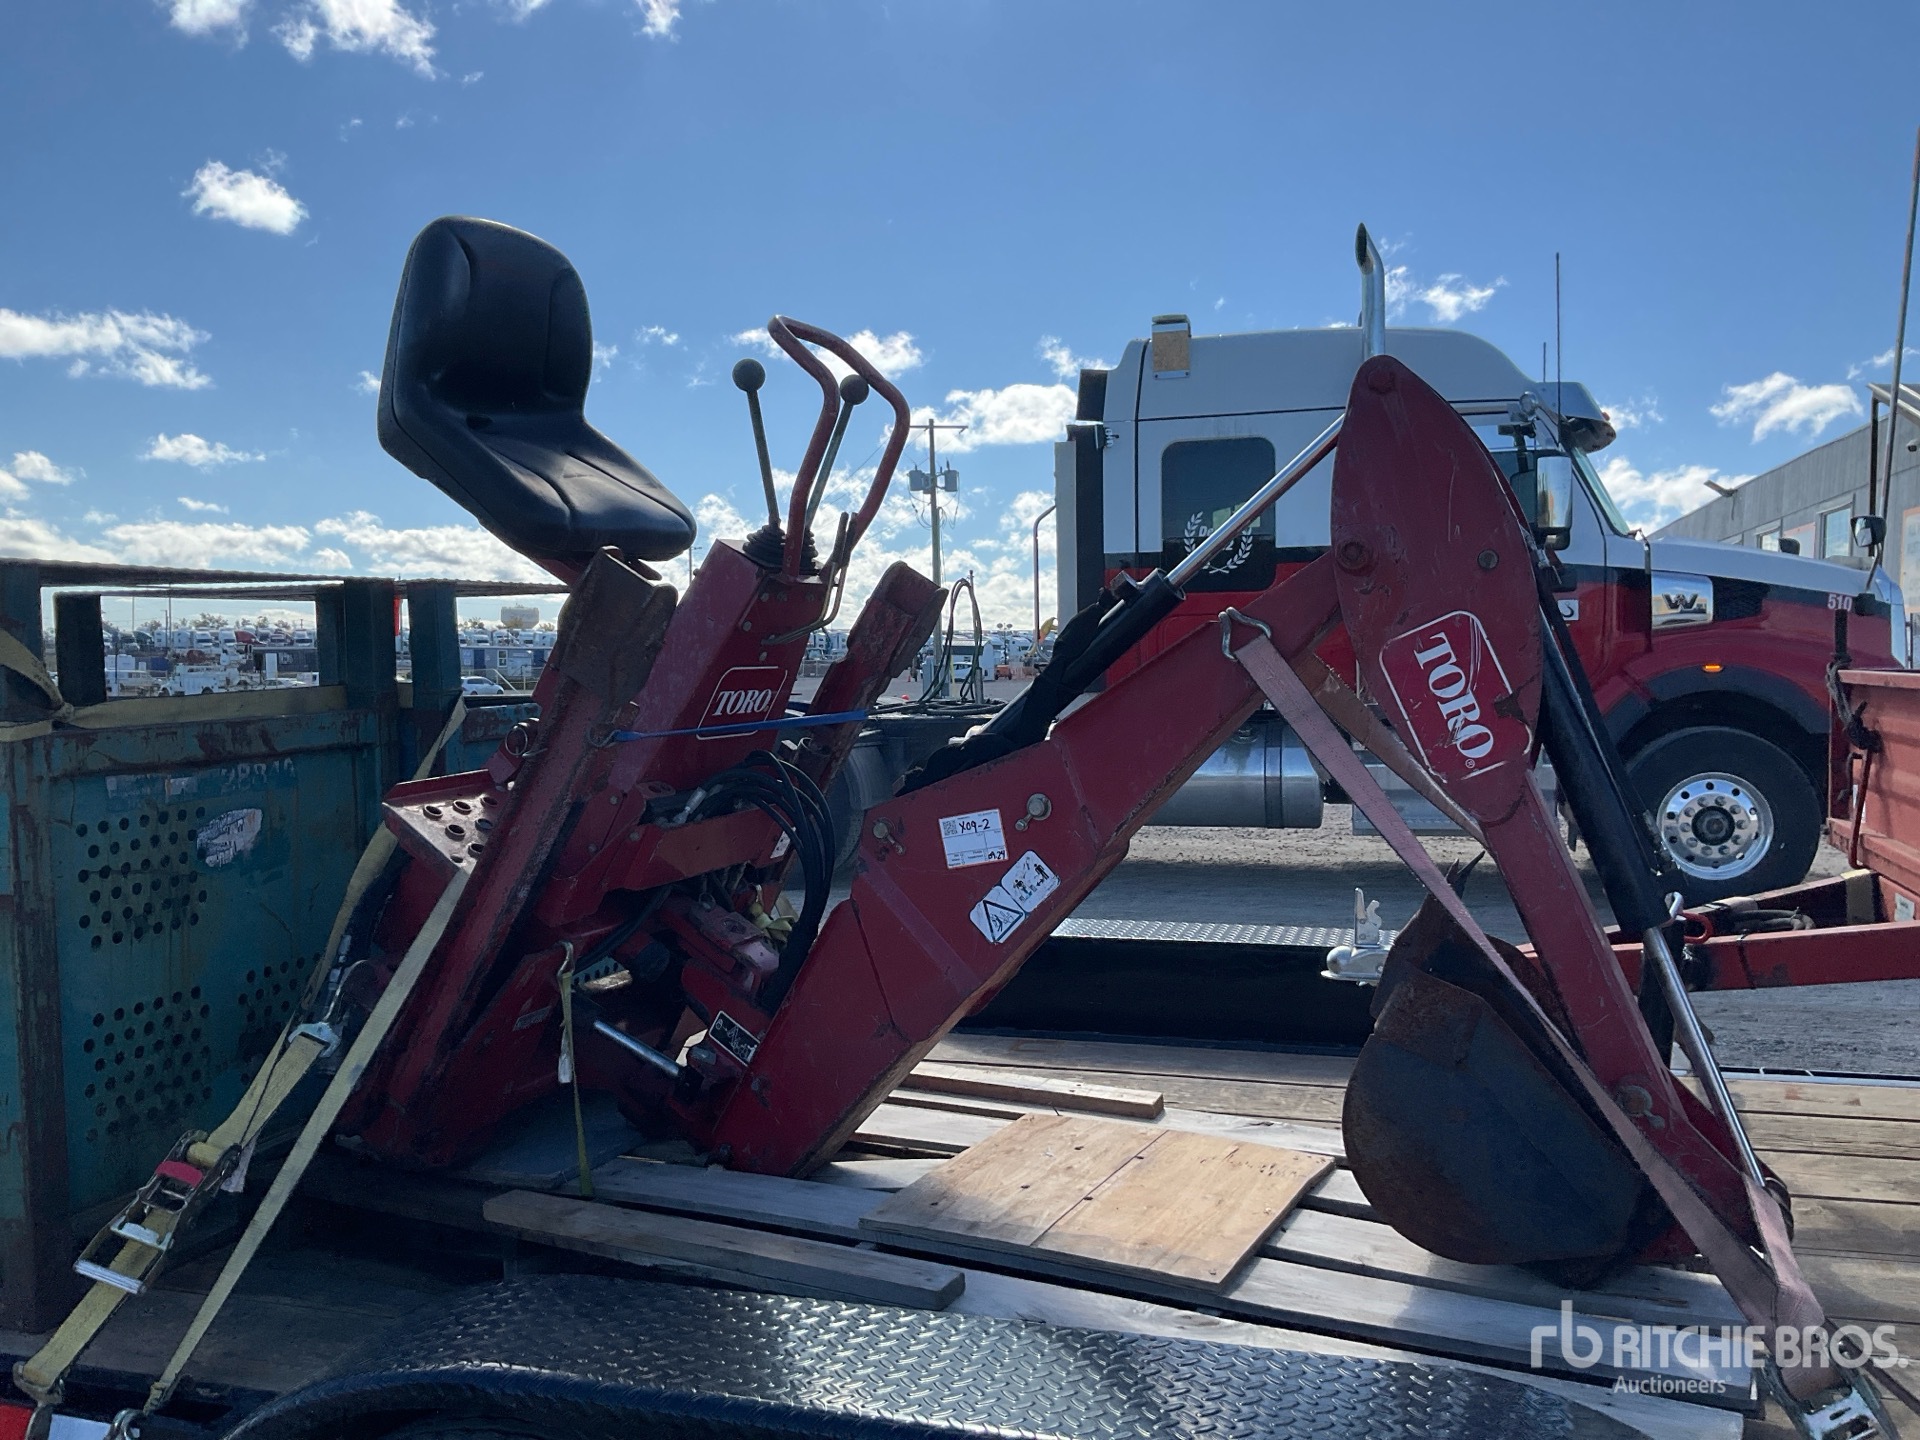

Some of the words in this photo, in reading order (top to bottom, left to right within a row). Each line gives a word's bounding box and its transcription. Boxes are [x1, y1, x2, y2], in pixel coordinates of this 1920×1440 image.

[1828, 593, 1853, 611] 510
[712, 689, 772, 715] TORO
[958, 818, 990, 833] X09-2
